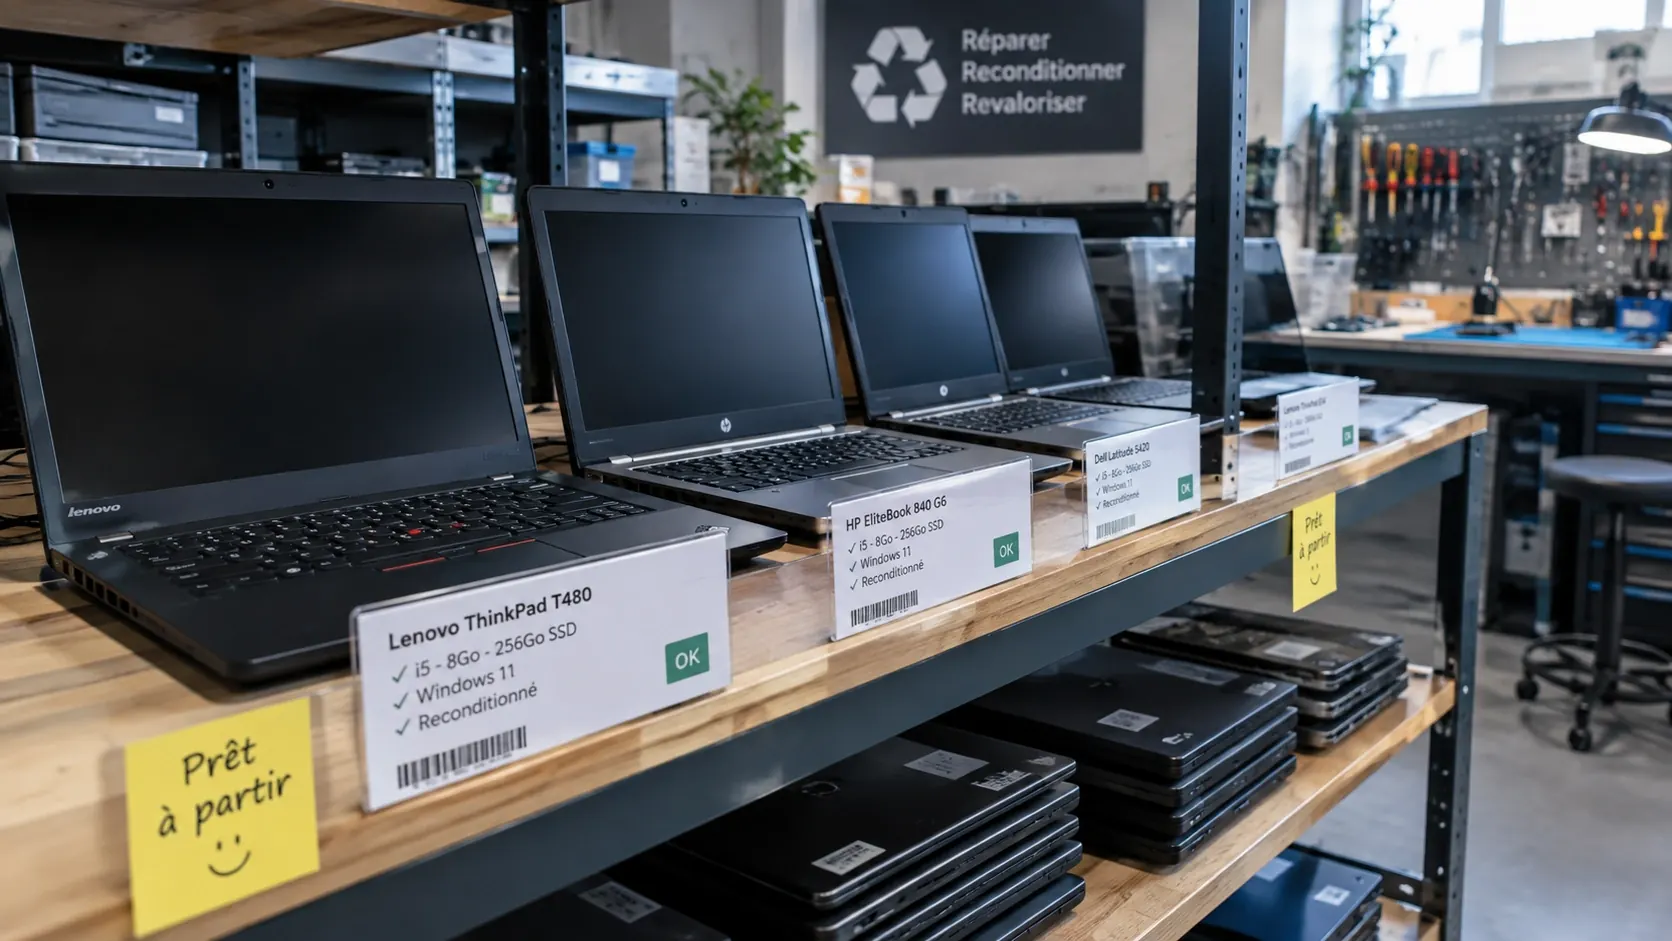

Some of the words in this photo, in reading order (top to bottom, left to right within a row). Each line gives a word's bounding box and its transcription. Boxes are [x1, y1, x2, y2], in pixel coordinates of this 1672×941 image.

[962, 27, 1051, 56] Réparer
[962, 58, 1126, 82] Reconditionner
[962, 89, 1087, 115] Revaloriser
[1095, 452, 1108, 465] Dell
[1135, 442, 1150, 454] 5420
[1181, 484, 1191, 495] OK
[68, 504, 121, 518] lenovo
[846, 517, 861, 532] HP
[864, 505, 912, 527] EliteBook
[914, 500, 932, 514] 840
[934, 496, 947, 509] G6
[860, 540, 868, 551] i5
[876, 535, 893, 547] 8Go
[900, 525, 927, 541] 256Go
[928, 519, 944, 533] SSD
[1308, 531, 1331, 561] partir
[861, 551, 901, 570] Windows
[903, 546, 911, 557] 11
[1000, 542, 1014, 558] OK
[862, 559, 924, 588] Reconditionné
[388, 622, 460, 651] Lenovo
[464, 597, 547, 632] ThinkPad
[551, 587, 593, 610] T480
[415, 661, 431, 678] i5
[447, 649, 481, 670] 8Go
[495, 633, 545, 657] 256Go
[549, 622, 578, 642] SSD
[675, 647, 701, 670] OK
[417, 671, 495, 705] Windows
[500, 664, 515, 681] 11
[419, 681, 538, 731] Reconditionné
[182, 737, 257, 786] Prêt
[158, 805, 178, 838] à
[195, 769, 292, 837] partir
